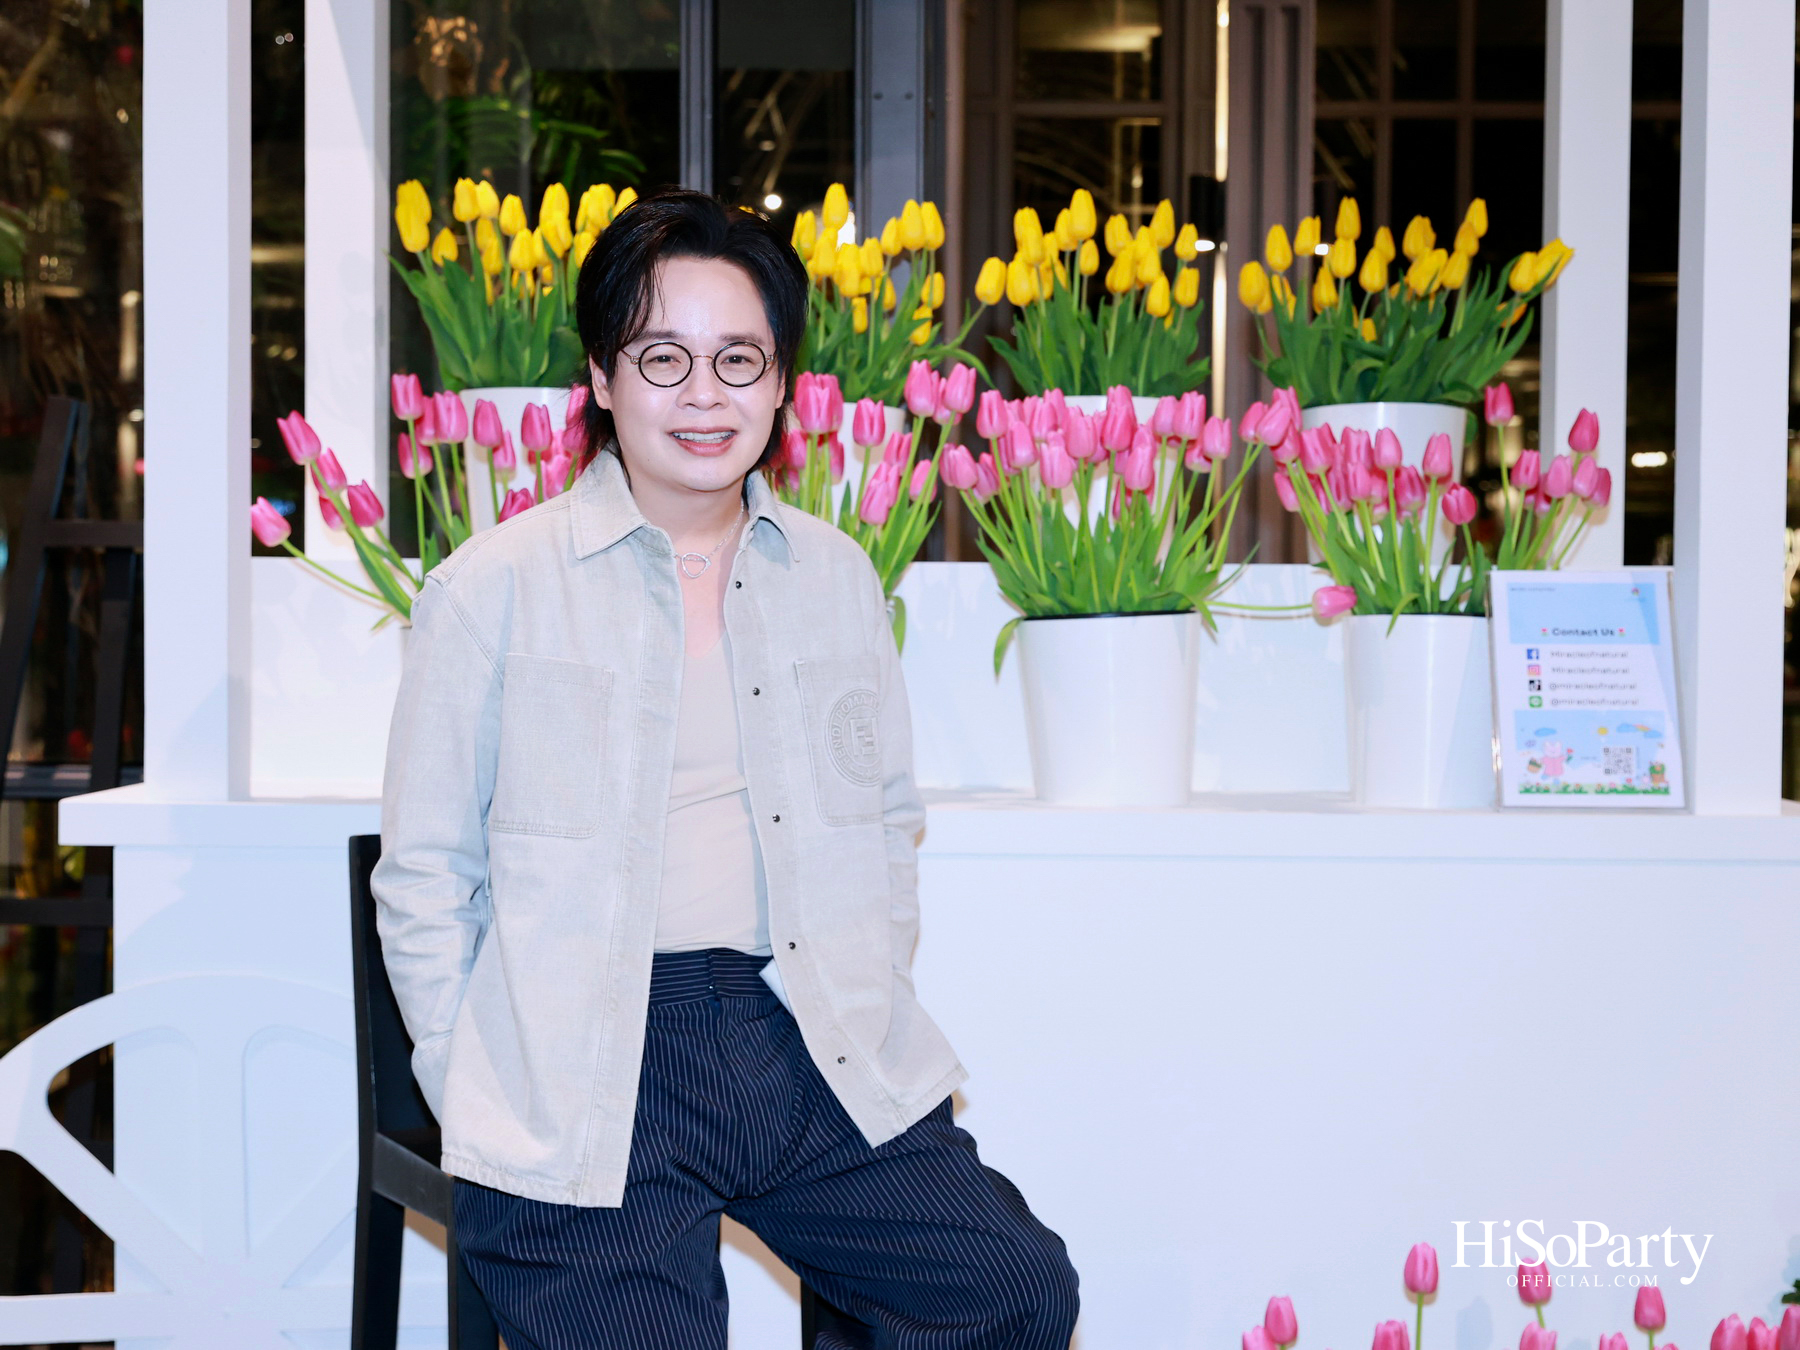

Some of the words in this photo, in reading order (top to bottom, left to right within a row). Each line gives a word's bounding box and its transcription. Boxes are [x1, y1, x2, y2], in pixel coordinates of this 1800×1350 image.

[1551, 627, 1599, 637] Contact
[1600, 627, 1616, 637] Us
[836, 694, 866, 720] ROMA
[831, 722, 851, 767] FENDI
